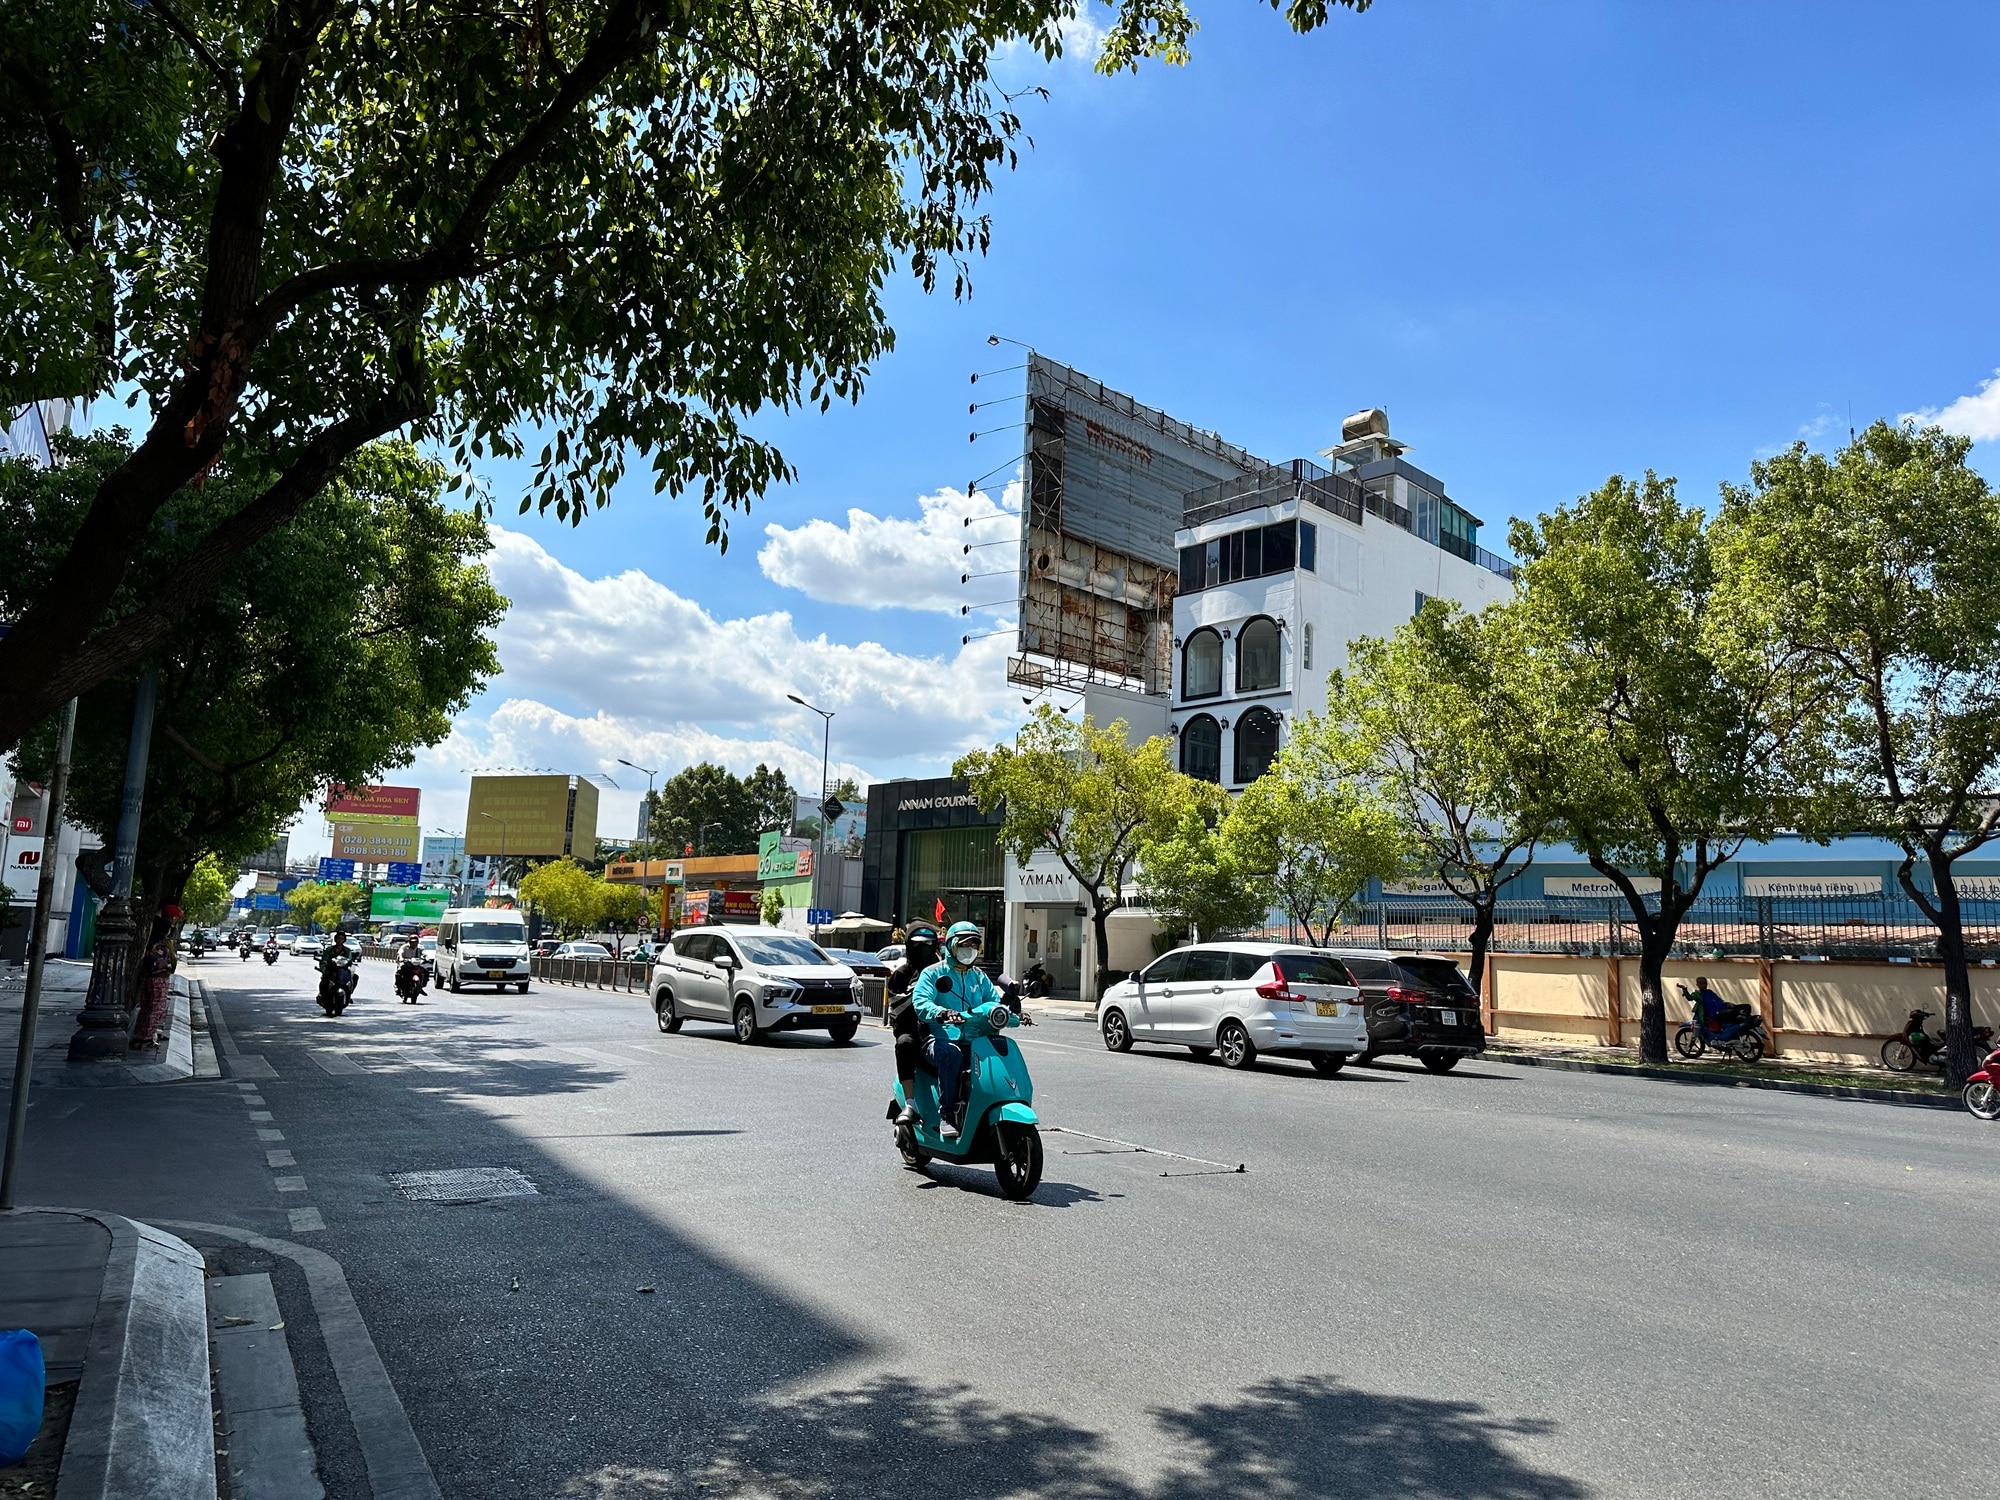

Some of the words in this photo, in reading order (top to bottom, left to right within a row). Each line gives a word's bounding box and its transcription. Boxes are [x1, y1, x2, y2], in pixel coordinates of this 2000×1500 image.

[897, 797, 933, 811] ANNAM
[934, 794, 981, 809] GOURME
[340, 835, 367, 845] (028)
[370, 836, 393, 846] 3844
[343, 846, 368, 855] 0908
[370, 847, 388, 856] 343
[391, 848, 407, 857] 180
[1407, 883, 1463, 893] MegaWn
[1571, 883, 1619, 892] MetroN
[1825, 882, 1854, 894] riêng
